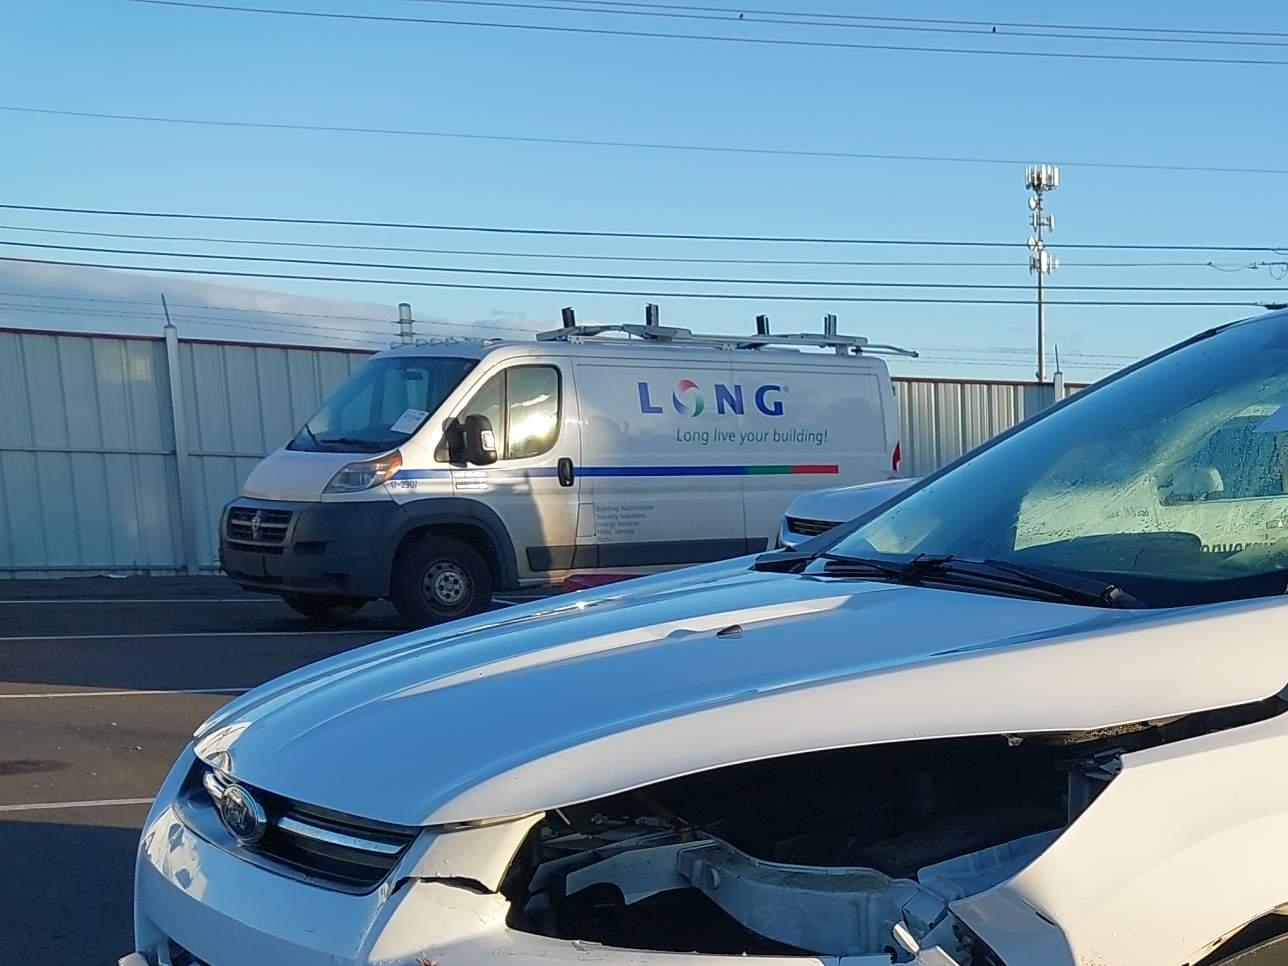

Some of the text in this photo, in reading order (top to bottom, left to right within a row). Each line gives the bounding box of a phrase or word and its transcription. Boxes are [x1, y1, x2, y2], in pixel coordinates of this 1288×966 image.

[637, 378, 784, 417] LONG
[676, 427, 828, 445] Long live your building!
